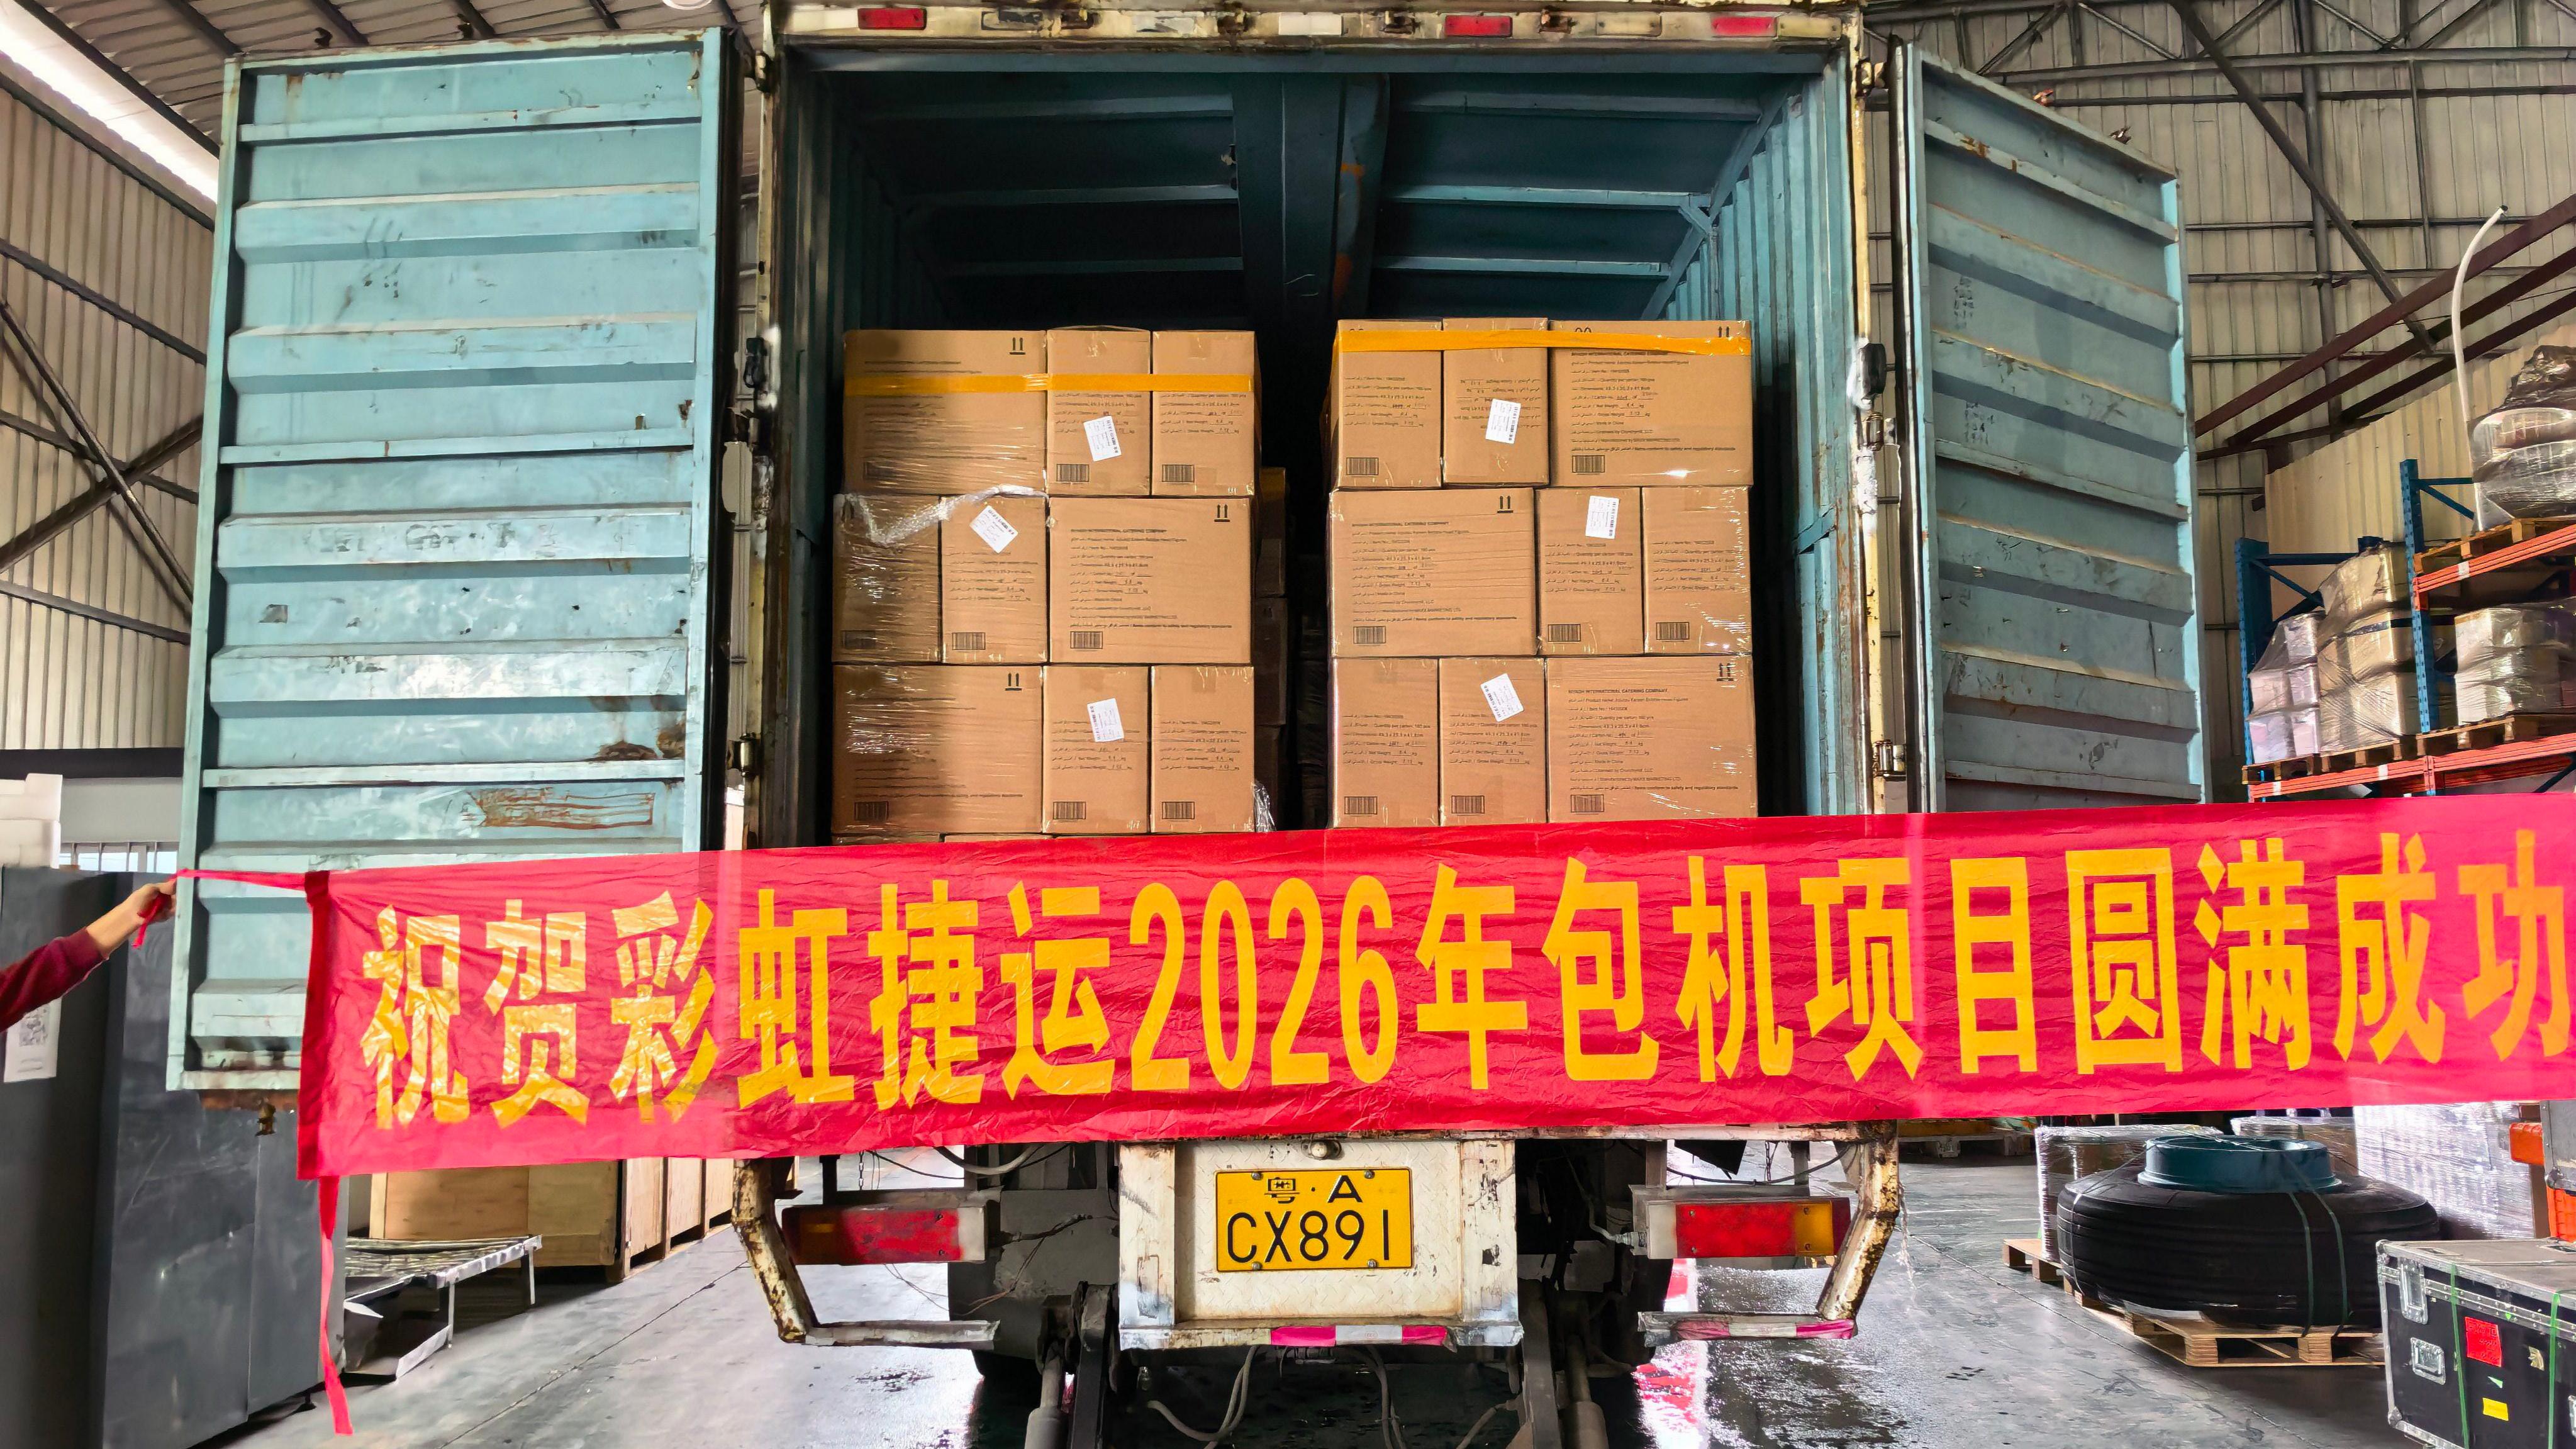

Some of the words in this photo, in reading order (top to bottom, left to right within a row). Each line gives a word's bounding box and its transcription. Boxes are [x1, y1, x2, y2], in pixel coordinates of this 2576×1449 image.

[361, 829, 2571, 1130] 祝贺彩虹捷运2026年包机项目圆满成功
[1227, 1209, 1390, 1263] CX891
